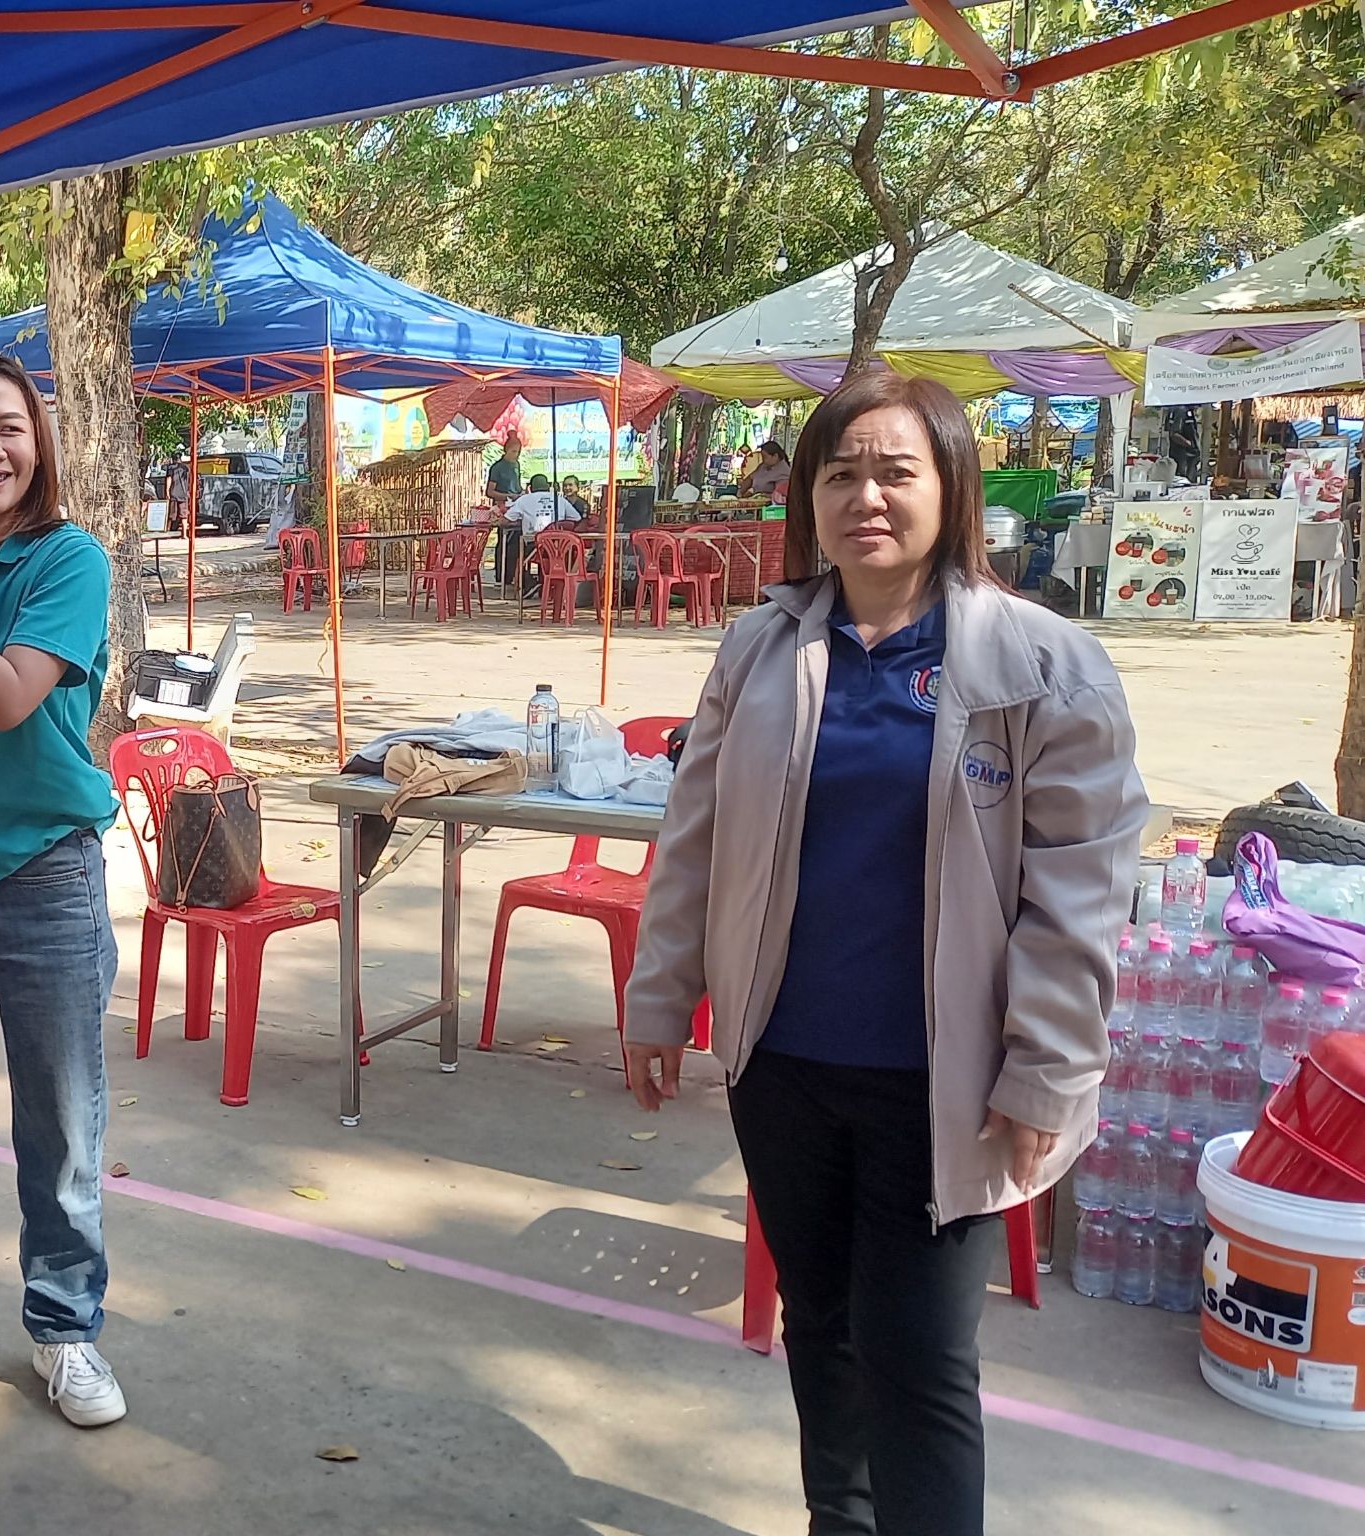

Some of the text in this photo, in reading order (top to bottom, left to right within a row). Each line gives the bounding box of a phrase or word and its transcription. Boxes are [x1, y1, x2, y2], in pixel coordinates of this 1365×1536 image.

[1163, 384, 1187, 393] Young
[1212, 382, 1240, 390] Farmer
[1268, 370, 1307, 382] Northeast
[1309, 362, 1345, 373] Thailand
[1222, 507, 1275, 517] กาแฟสด
[1211, 568, 1234, 576] Miss
[1259, 567, 1281, 576] café
[966, 764, 1011, 786] GMP
